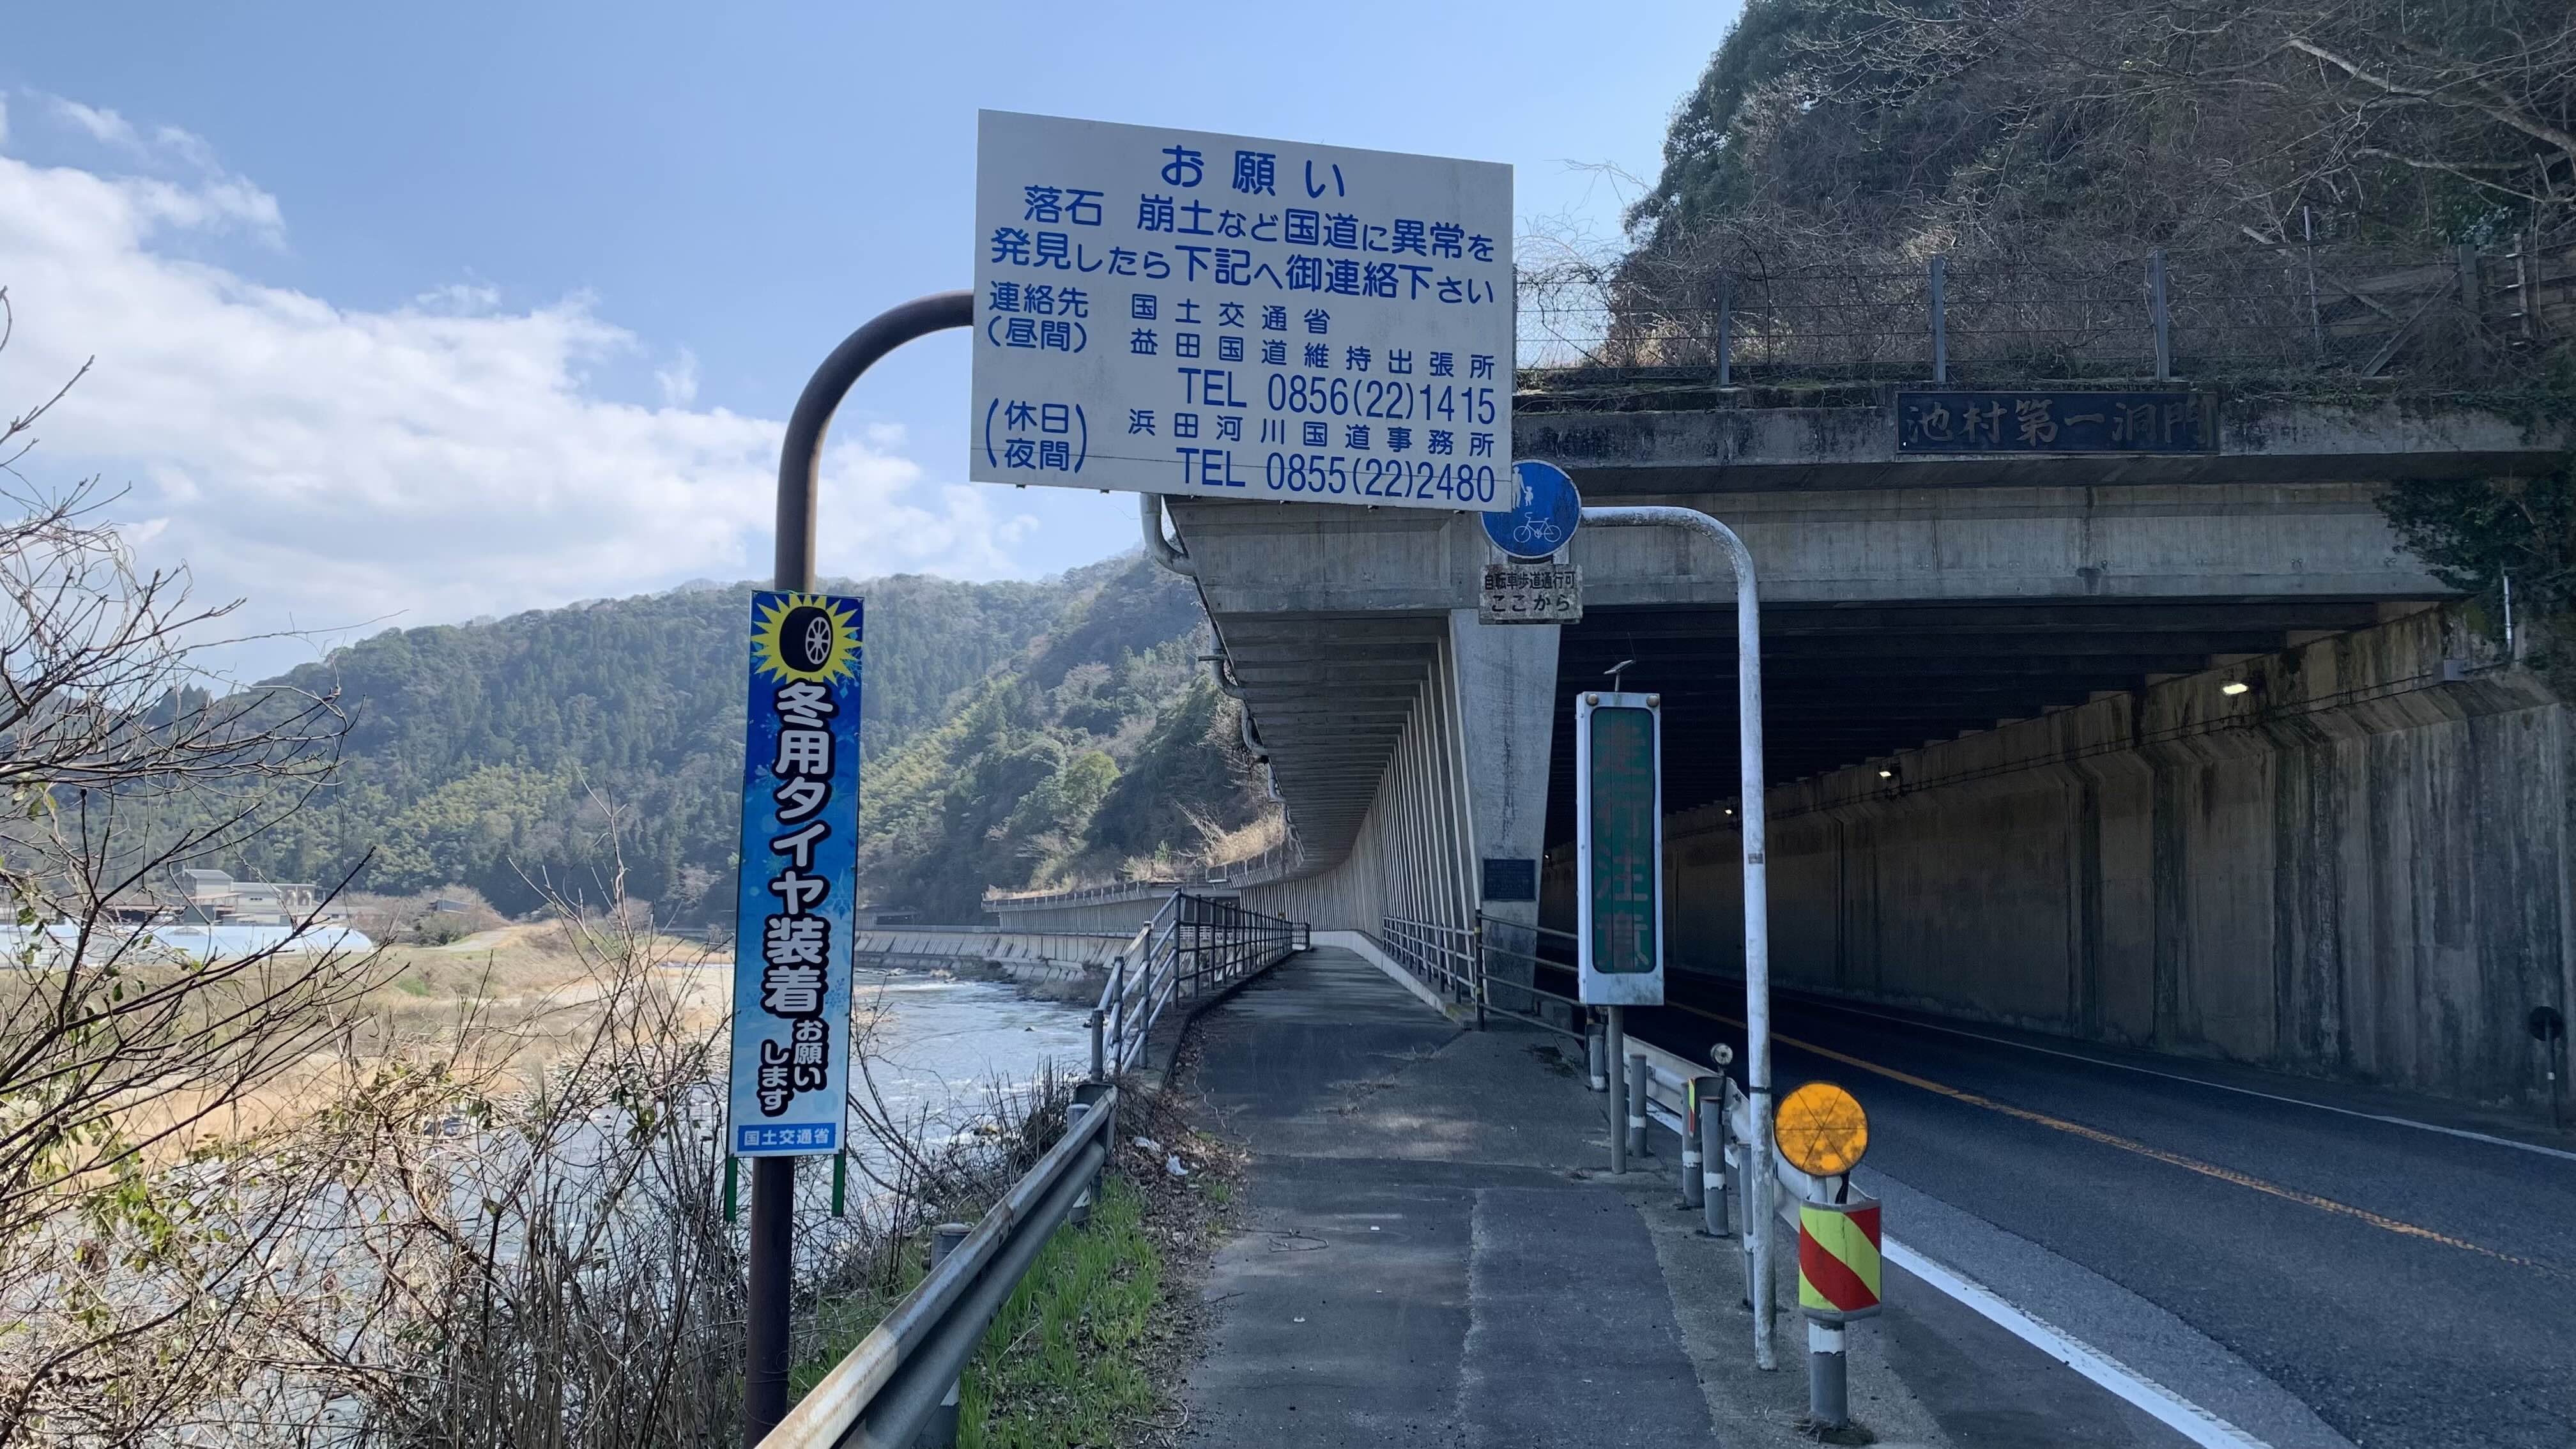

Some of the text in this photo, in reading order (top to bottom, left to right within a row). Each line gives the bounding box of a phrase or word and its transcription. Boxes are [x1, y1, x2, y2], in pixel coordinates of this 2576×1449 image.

[1162, 145, 1344, 198] お願い
[1024, 185, 1494, 262] 落石 崩土など国道に異常を
[992, 227, 1493, 303] 発見したら下記へ御連絡下さい
[989, 281, 1089, 318] 連絡先
[1132, 294, 1330, 334] 国土交通省
[988, 316, 1087, 353] (昼間)
[1130, 328, 1494, 380] 益田国道維持出張所
[1178, 367, 1495, 424] TEL 0856(22)1415
[1128, 409, 1494, 457] 浜田河川国道事務所
[1906, 398, 2212, 447] 池村第一洞門
[1176, 447, 1494, 502] TEL 0855(22)2480
[1485, 571, 1575, 590] 自転車歩道通行可
[1492, 594, 1570, 612] ここから
[765, 682, 833, 1012] 冬用タイヤ装着
[760, 1043, 790, 1110] します
[793, 1020, 823, 1086] お願い
[744, 1128, 830, 1146] 国土交通省
